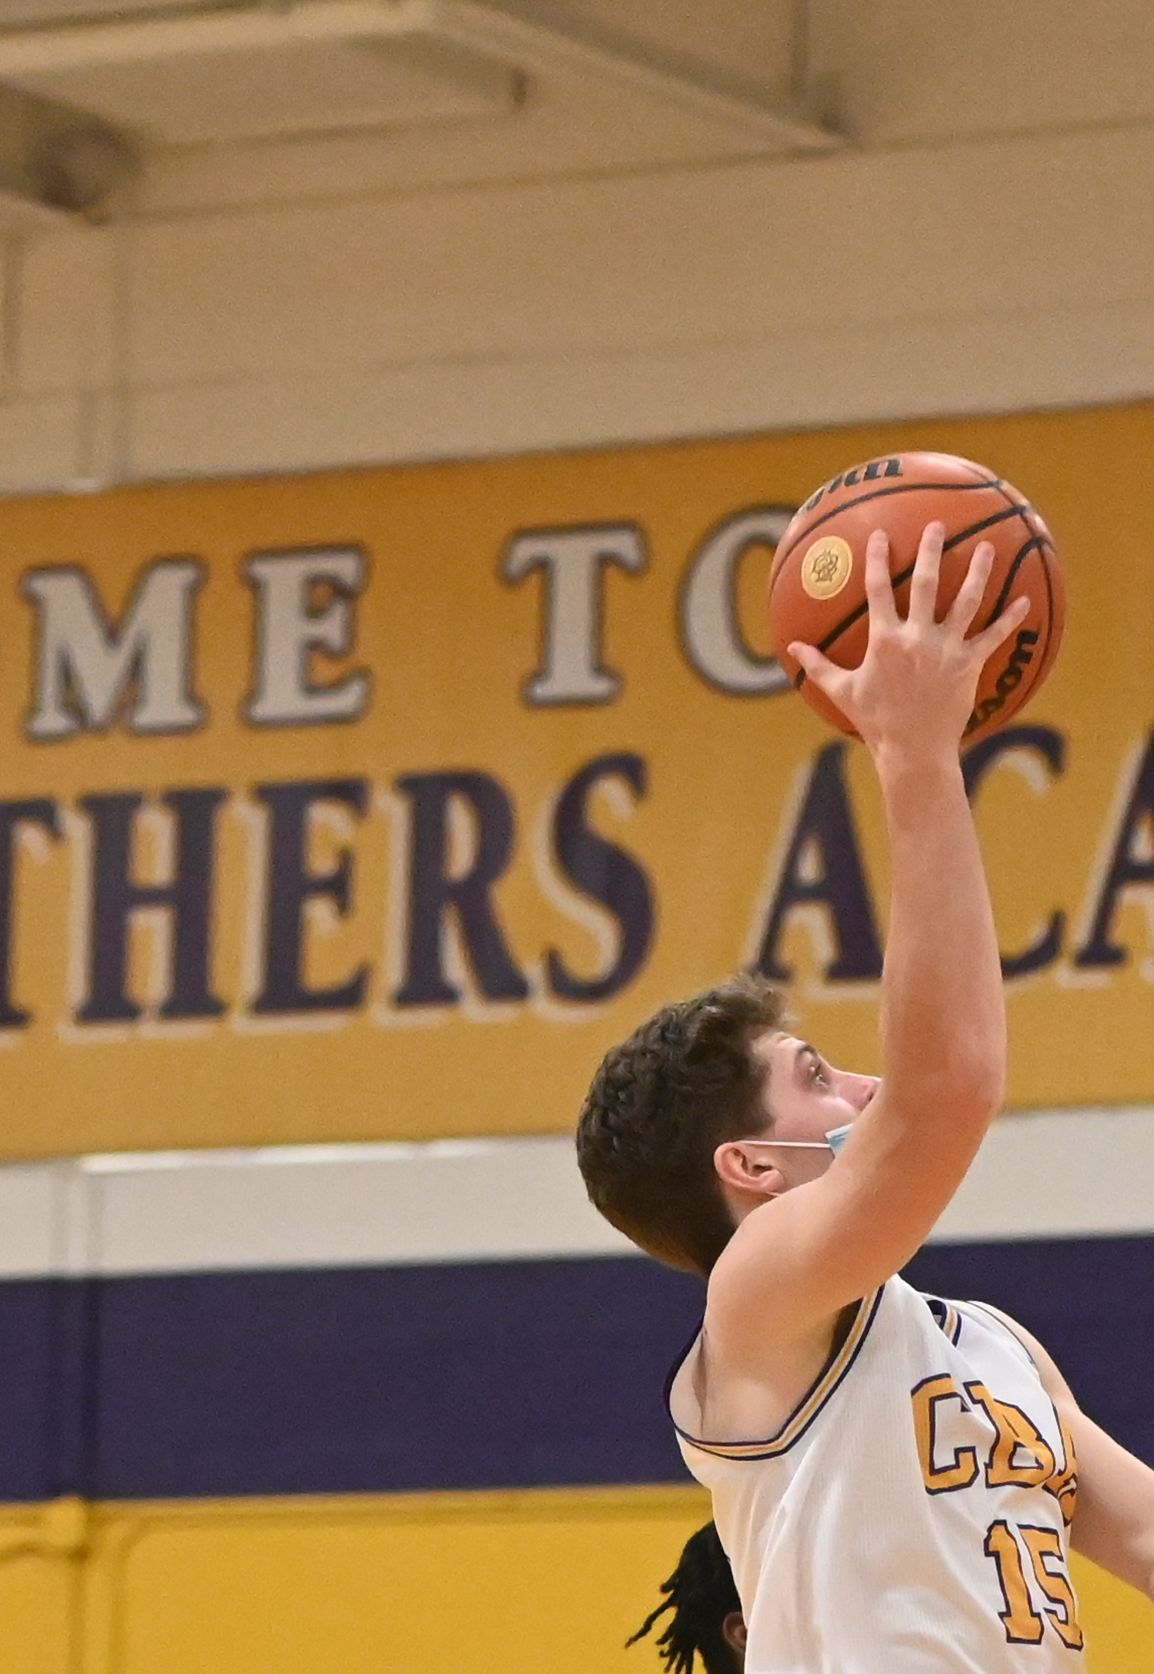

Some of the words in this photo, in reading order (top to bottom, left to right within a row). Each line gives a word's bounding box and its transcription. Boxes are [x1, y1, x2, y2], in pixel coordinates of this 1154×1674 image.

[22, 543, 374, 744] ME
[500, 505, 795, 708] TO
[983, 1517, 1085, 1652] 15
